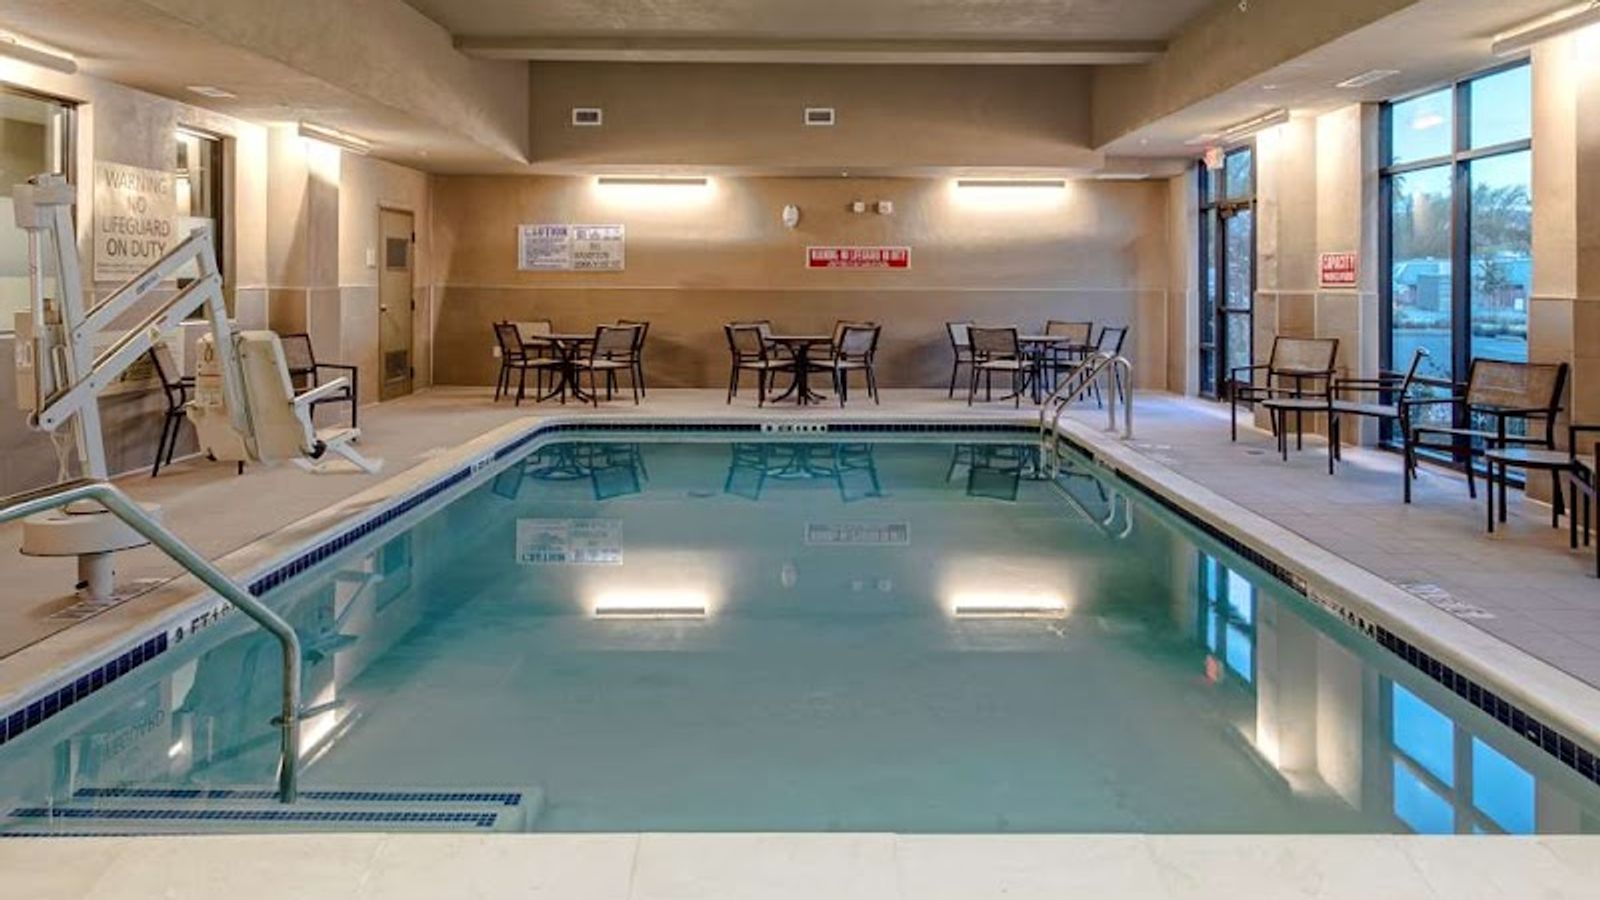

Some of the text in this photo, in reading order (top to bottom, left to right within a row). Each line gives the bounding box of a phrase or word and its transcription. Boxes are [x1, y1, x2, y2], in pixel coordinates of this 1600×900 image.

[105, 168, 168, 195] WARNING
[102, 216, 171, 237] LIFEGUARD
[106, 238, 167, 257] ON DUTY
